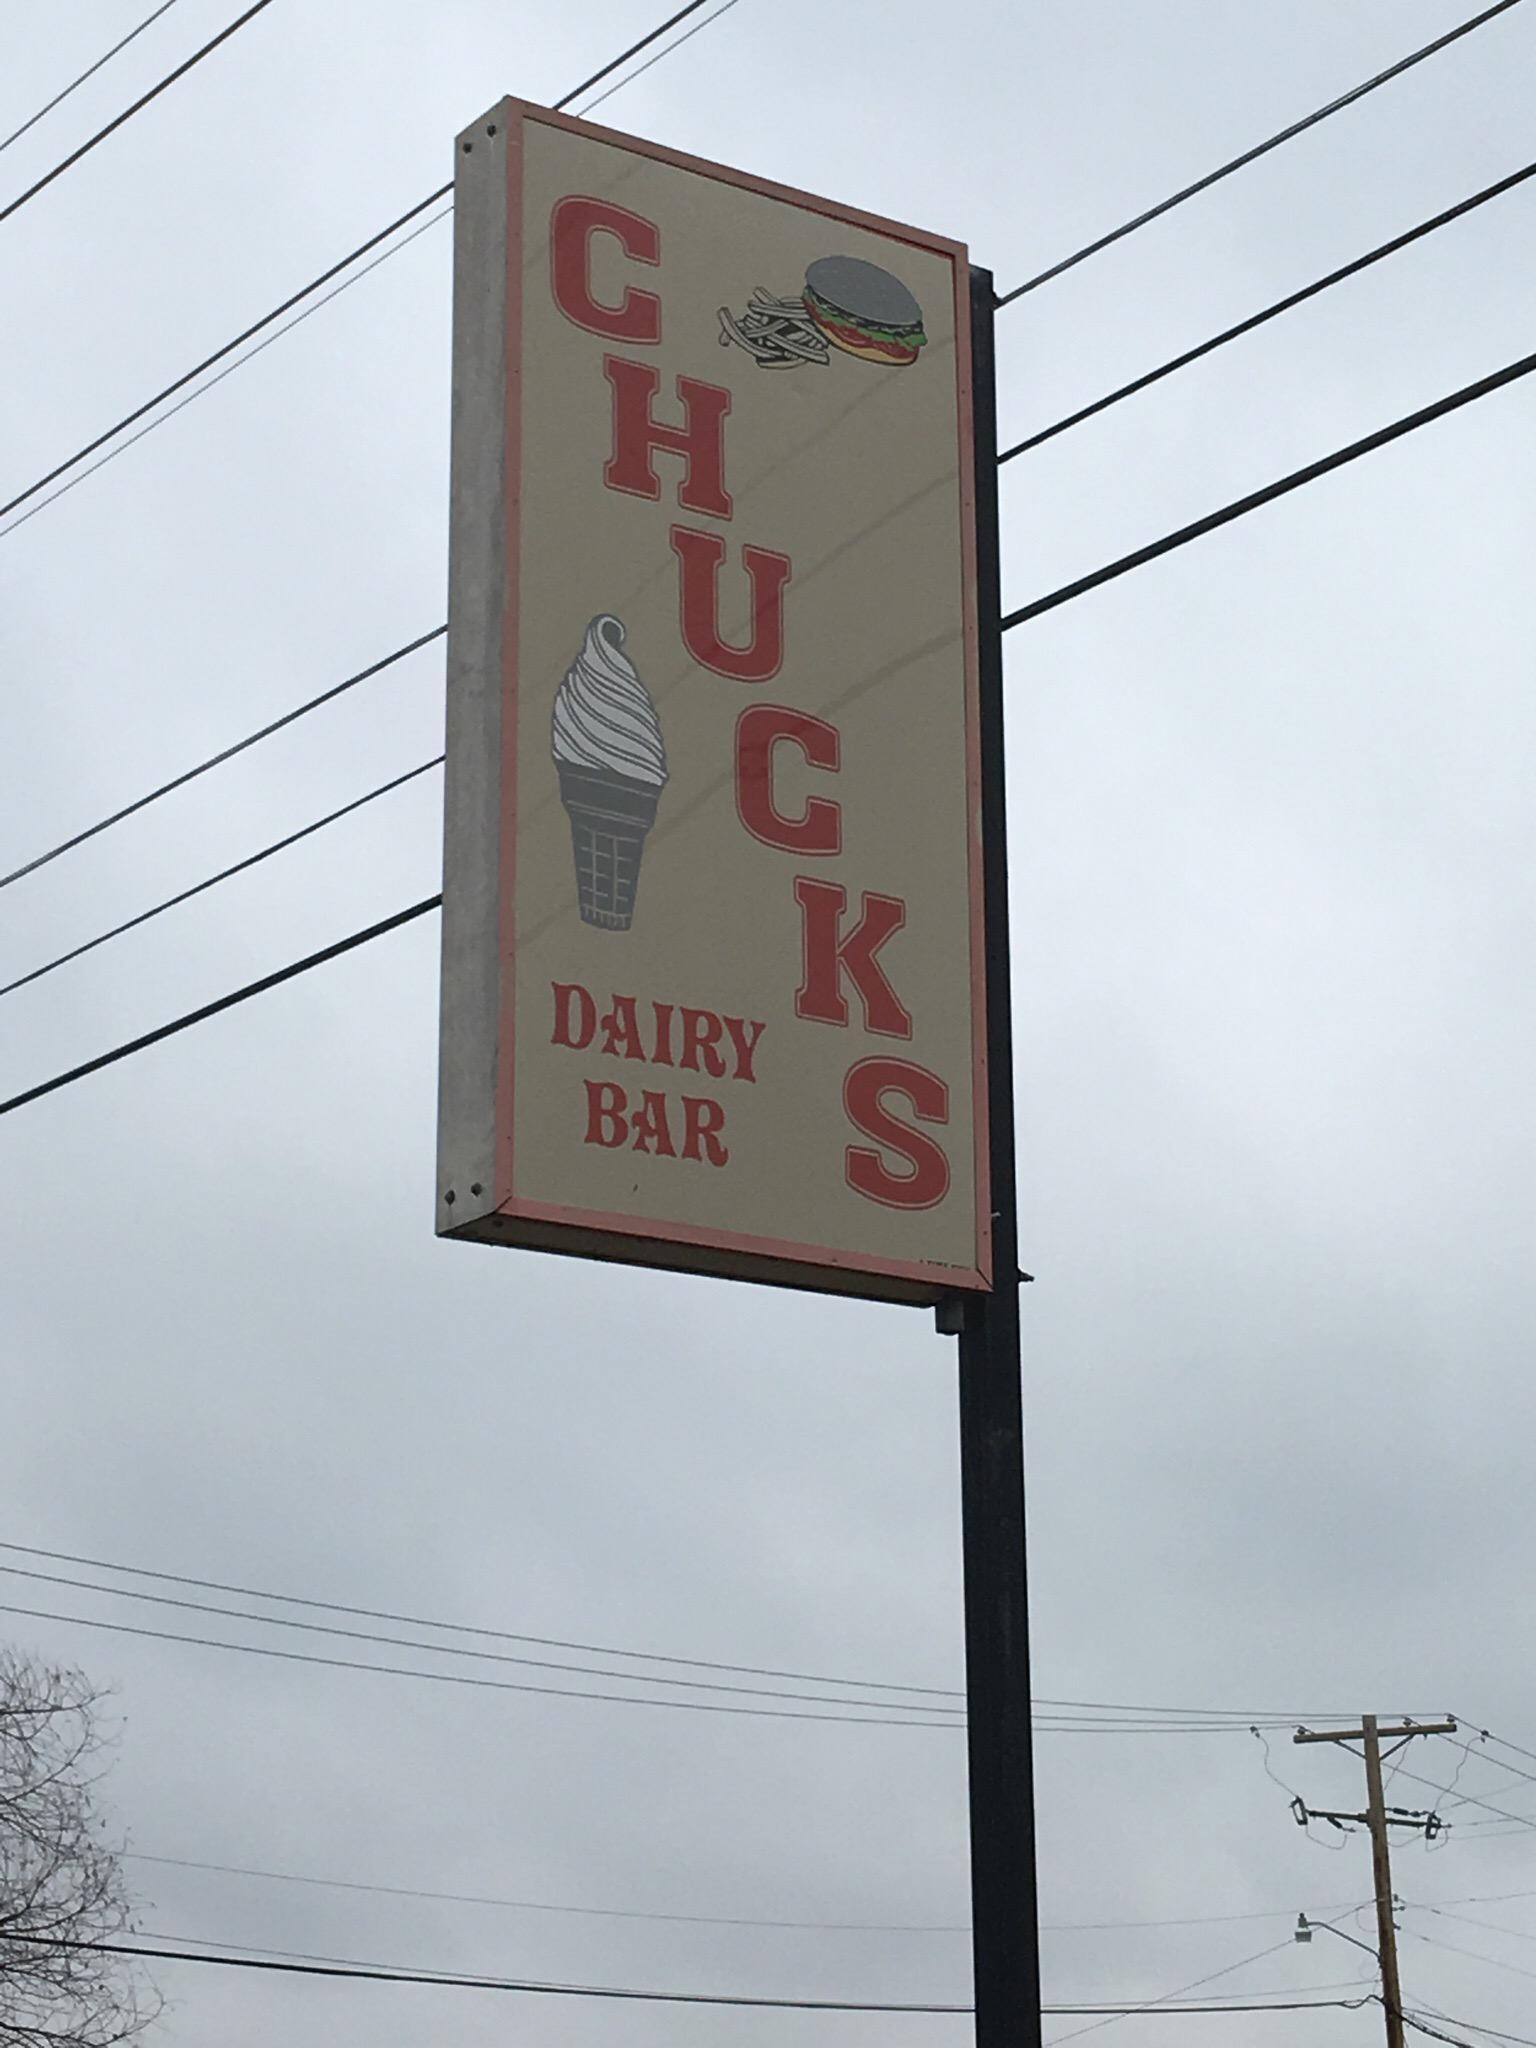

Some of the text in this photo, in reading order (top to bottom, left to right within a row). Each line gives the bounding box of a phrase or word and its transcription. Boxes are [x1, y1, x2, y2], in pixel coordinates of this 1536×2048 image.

[549, 194, 951, 1210] CHUCKS
[551, 981, 766, 1083] DAIRY
[583, 1078, 729, 1168] BAR
